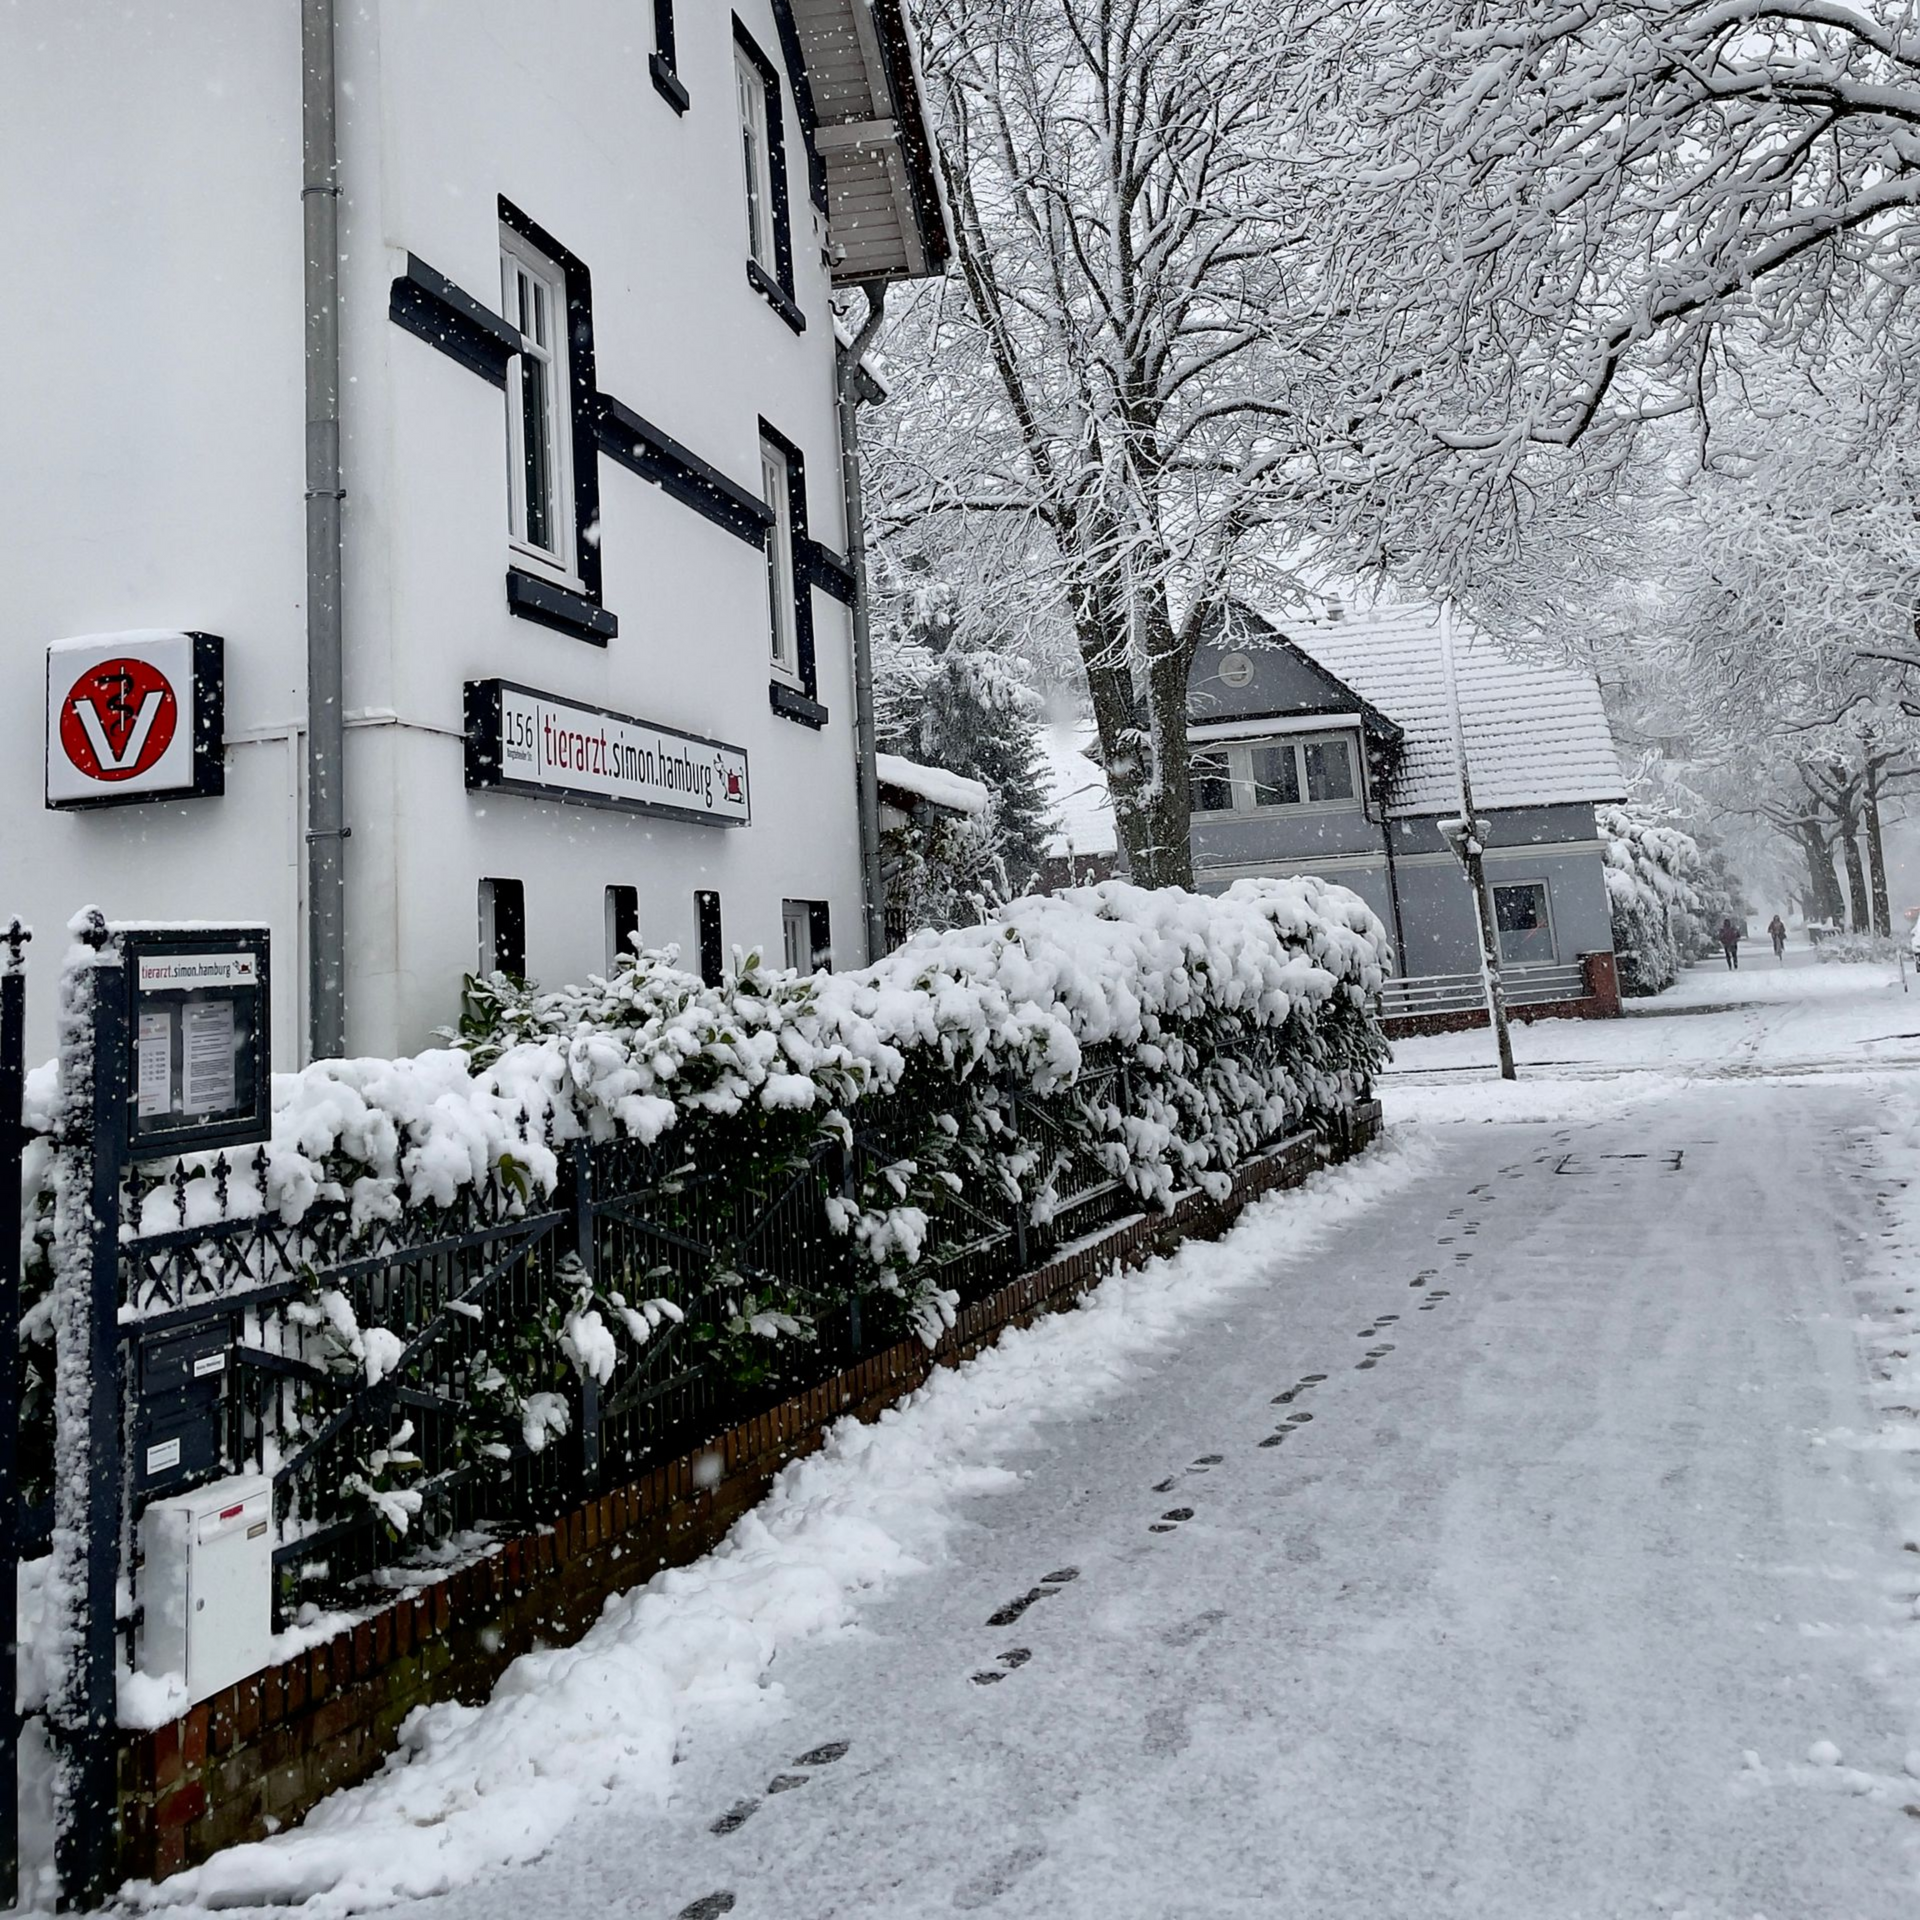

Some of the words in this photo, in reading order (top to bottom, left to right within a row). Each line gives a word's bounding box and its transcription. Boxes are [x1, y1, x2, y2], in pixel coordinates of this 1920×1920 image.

[73, 690, 164, 771] V
[506, 711, 533, 748] 156
[544, 713, 713, 808] tierarzt.simon.hamburg
[141, 962, 231, 979] tierarzt.simon.hamburg
